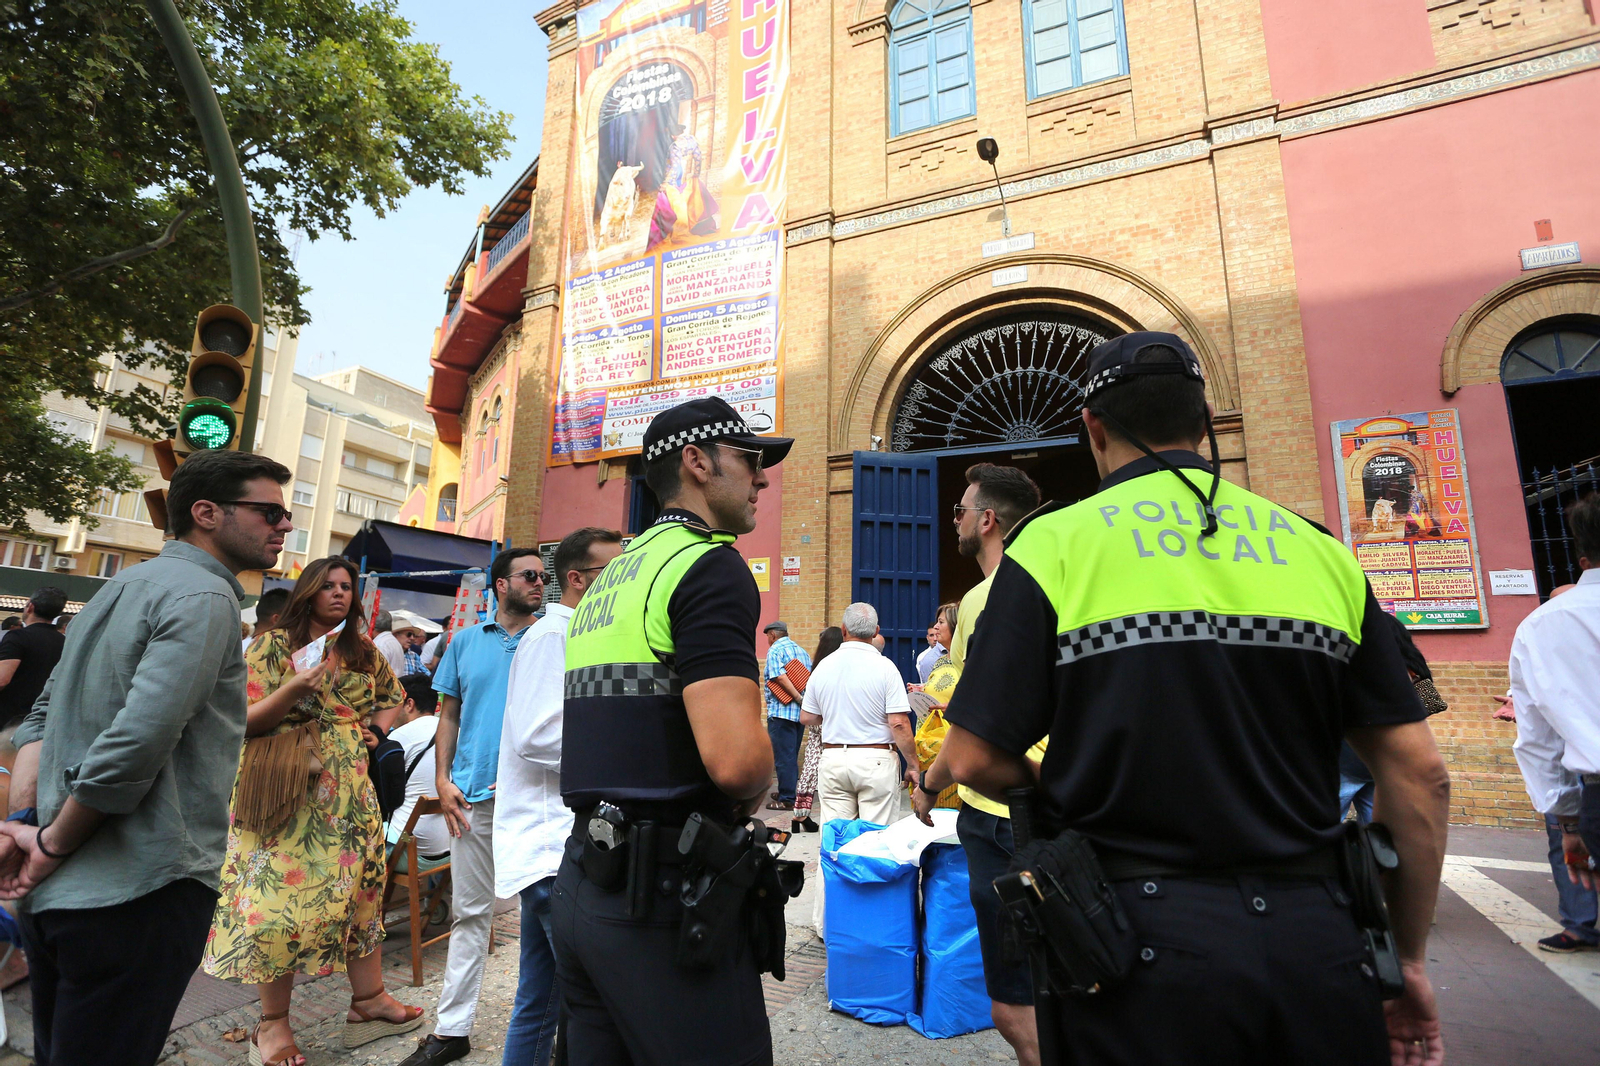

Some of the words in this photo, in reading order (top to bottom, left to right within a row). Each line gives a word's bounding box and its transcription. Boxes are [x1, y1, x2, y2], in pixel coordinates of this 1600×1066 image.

[613, 72, 681, 98] Colombinas
[626, 63, 670, 84] Fiestas
[619, 86, 672, 114] 2018
[671, 243, 713, 259] Viernes,
[716, 240, 727, 249] 3
[729, 234, 768, 248] Agosto
[604, 268, 613, 278] 2
[614, 261, 646, 276] Agosto
[666, 257, 688, 269] Gran
[690, 252, 726, 263] Corrida
[666, 269, 717, 286] MORANTE
[727, 260, 772, 274] PUEBLA
[620, 269, 650, 281] Picadores
[686, 269, 772, 291] MANZANARES
[606, 284, 650, 302] SILVERA
[666, 291, 700, 305] DAVID
[714, 278, 772, 295] MIRANDA
[666, 310, 713, 325] Domingo,
[716, 304, 726, 314] 5
[729, 299, 768, 313] Agosto
[666, 325, 686, 334] Gran
[688, 318, 719, 329] Corrida
[735, 310, 771, 321] Rejones
[580, 340, 611, 350] Corrida
[613, 337, 625, 345] de
[627, 332, 650, 342] Toros
[600, 328, 609, 337] 4
[611, 324, 643, 338] Agosto
[666, 341, 693, 354] ANDY
[696, 327, 772, 347] CARTAGENA
[666, 347, 704, 362] DIEGO
[709, 337, 772, 354] VENTURA
[666, 356, 714, 371] ANDRES
[718, 346, 772, 363] ROMERO
[600, 359, 648, 373] PERERA
[608, 370, 634, 381] REY
[608, 385, 621, 393] LOS
[622, 381, 654, 391] FESTEJOS
[753, 361, 777, 370] TARDE
[608, 381, 691, 399] MANTENEMOS
[694, 374, 718, 386] LOS
[721, 366, 778, 381] PRECIOS
[611, 396, 644, 407] Telf.
[650, 391, 680, 402] 959
[686, 387, 707, 397] 28
[715, 382, 735, 393] 15
[740, 377, 762, 389] 00
[624, 402, 642, 410] ONLINE
[1375, 467, 1403, 476] 2018
[1434, 430, 1466, 533] HUELVA
[1099, 499, 1297, 535] POLICIA
[1131, 529, 1288, 566] LOCAL
[570, 591, 618, 639] LOCAL
